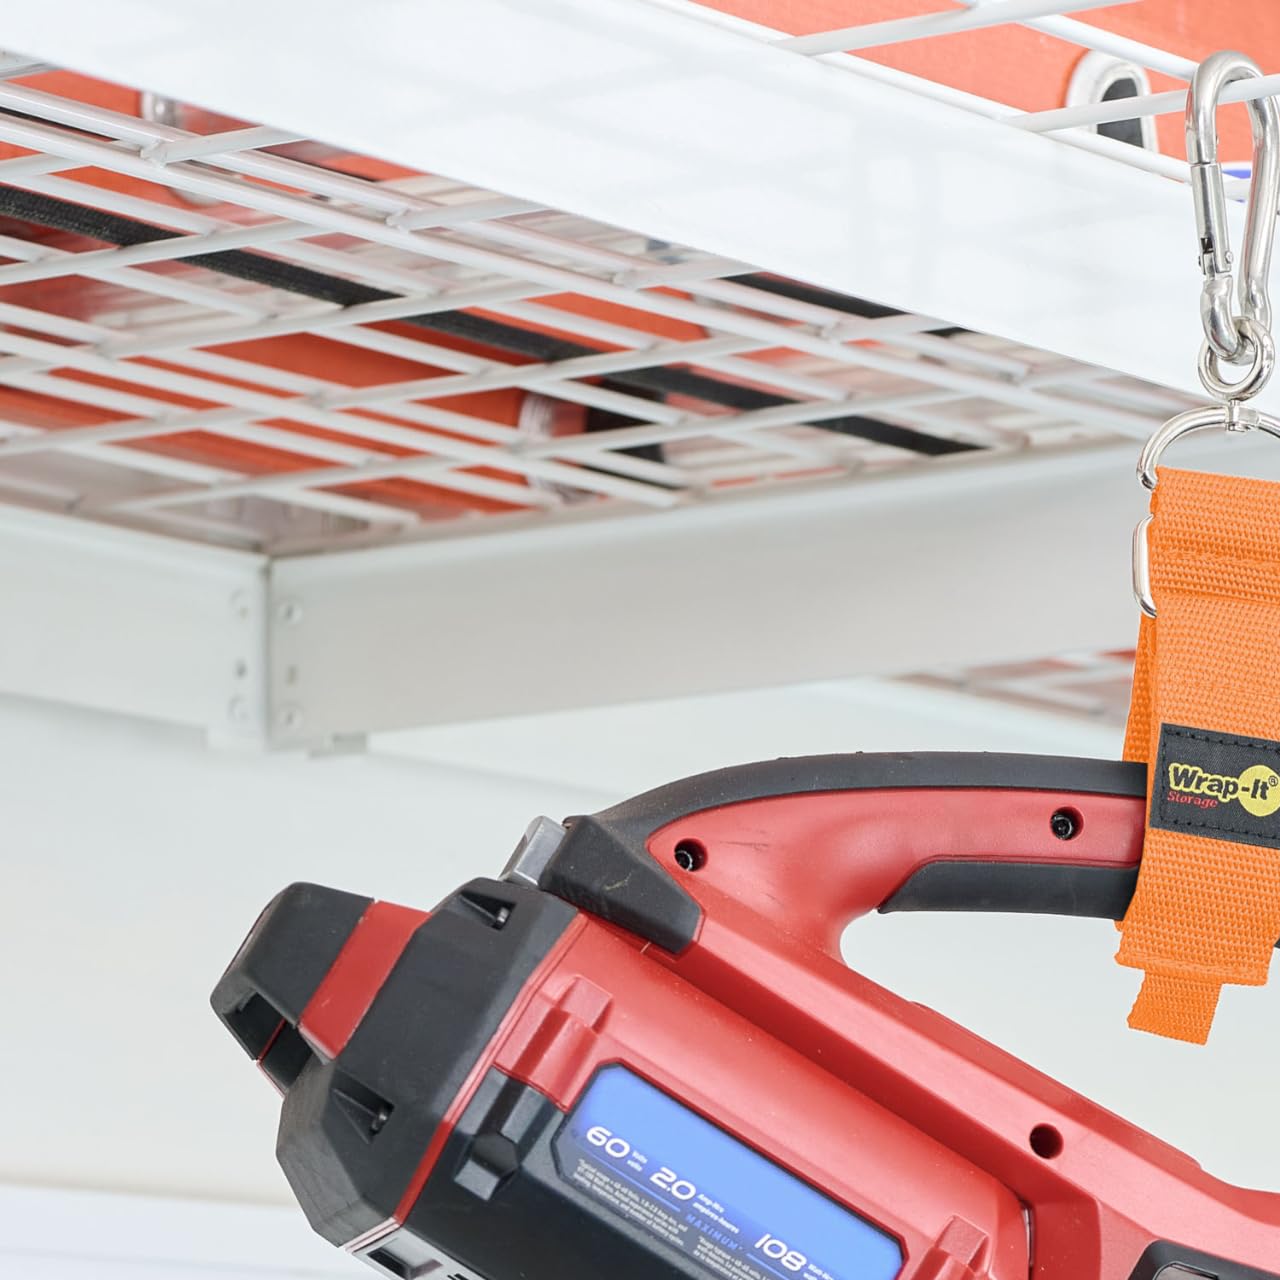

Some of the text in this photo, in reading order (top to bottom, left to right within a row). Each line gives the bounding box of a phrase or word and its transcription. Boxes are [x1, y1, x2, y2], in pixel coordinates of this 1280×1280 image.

[1167, 790, 1218, 809] Storage
[586, 1126, 631, 1158] 60
[649, 1166, 697, 1200] 2.0
[754, 1233, 807, 1272] 108
